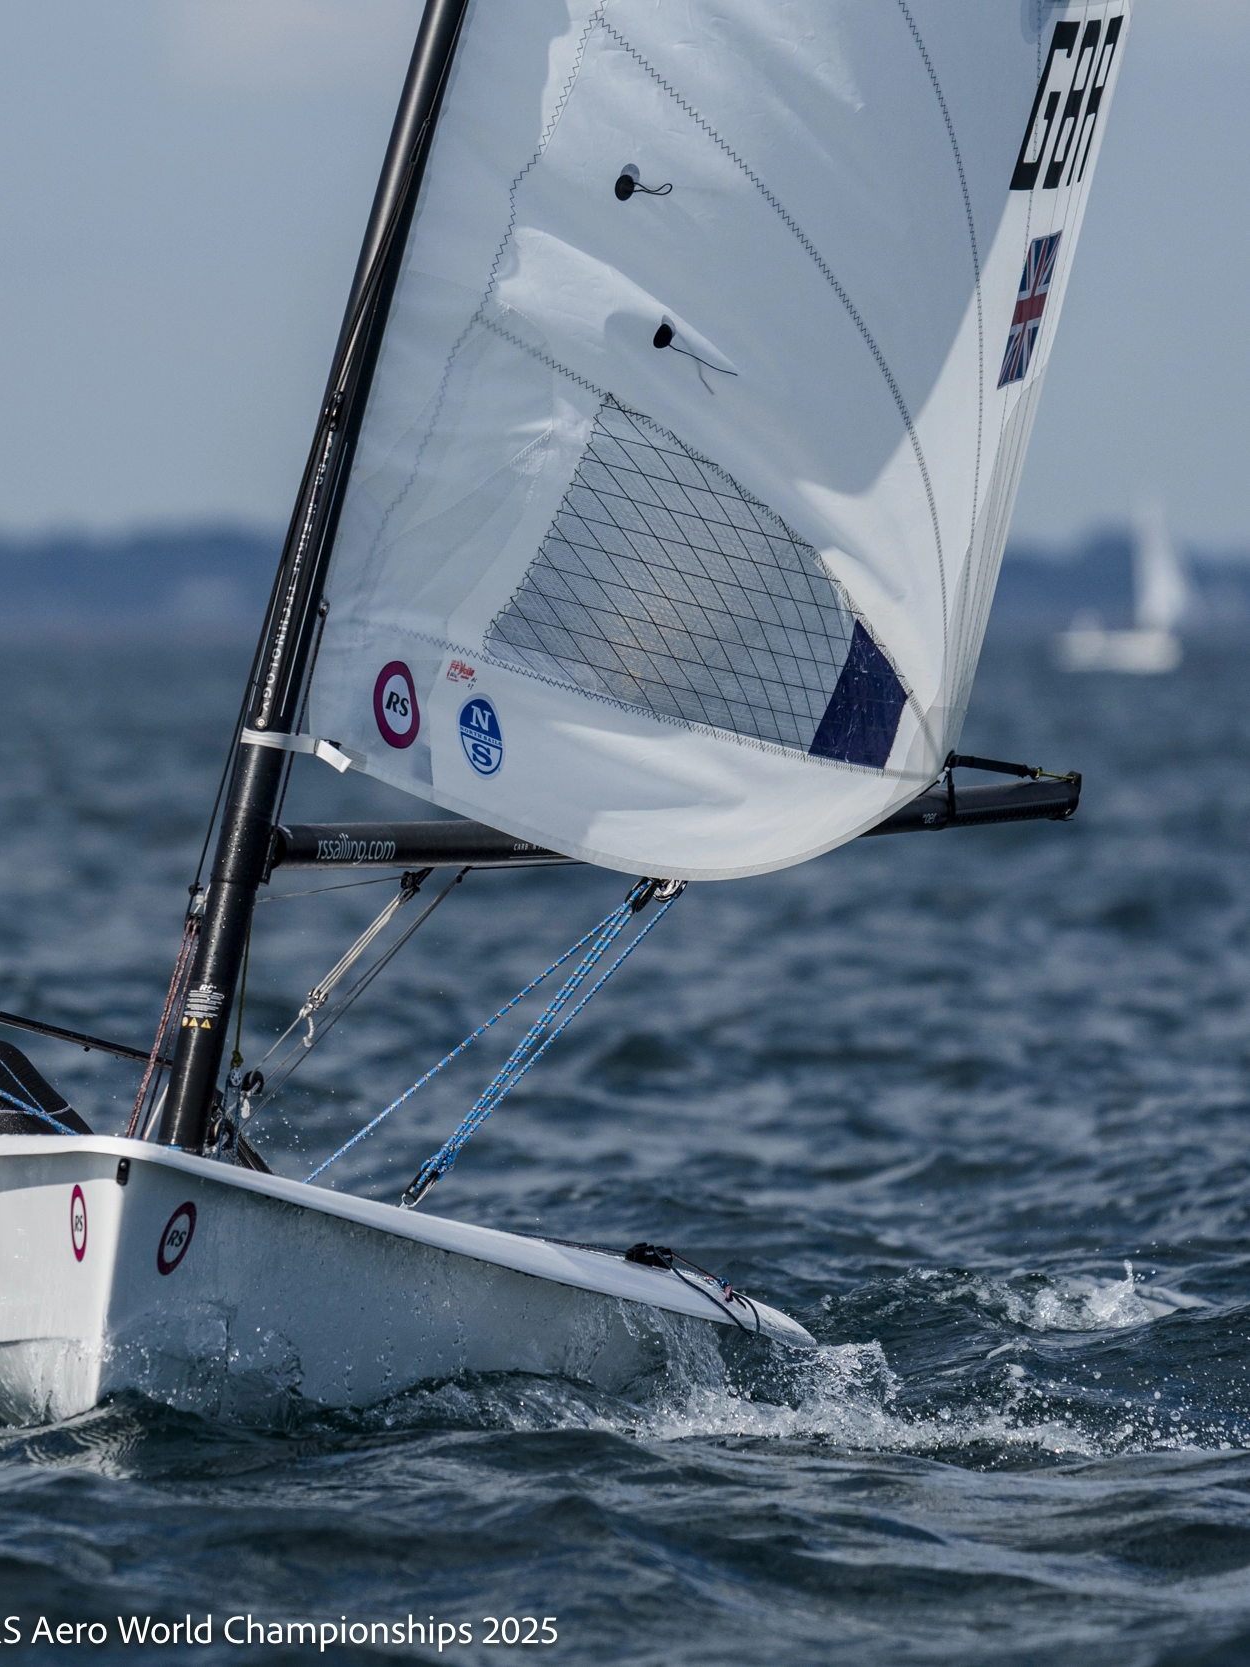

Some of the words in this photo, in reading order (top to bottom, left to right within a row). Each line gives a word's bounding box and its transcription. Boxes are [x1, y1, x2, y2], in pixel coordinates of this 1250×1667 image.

[1009, 15, 1124, 190] GBR
[384, 691, 410, 717] RS
[470, 705, 492, 731] N
[460, 725, 482, 739] NORTH
[483, 735, 503, 747] SAILS
[471, 743, 492, 767] S
[316, 833, 396, 865] rssailing.com
[74, 1215, 84, 1232] RS
[166, 1230, 187, 1247] RS
